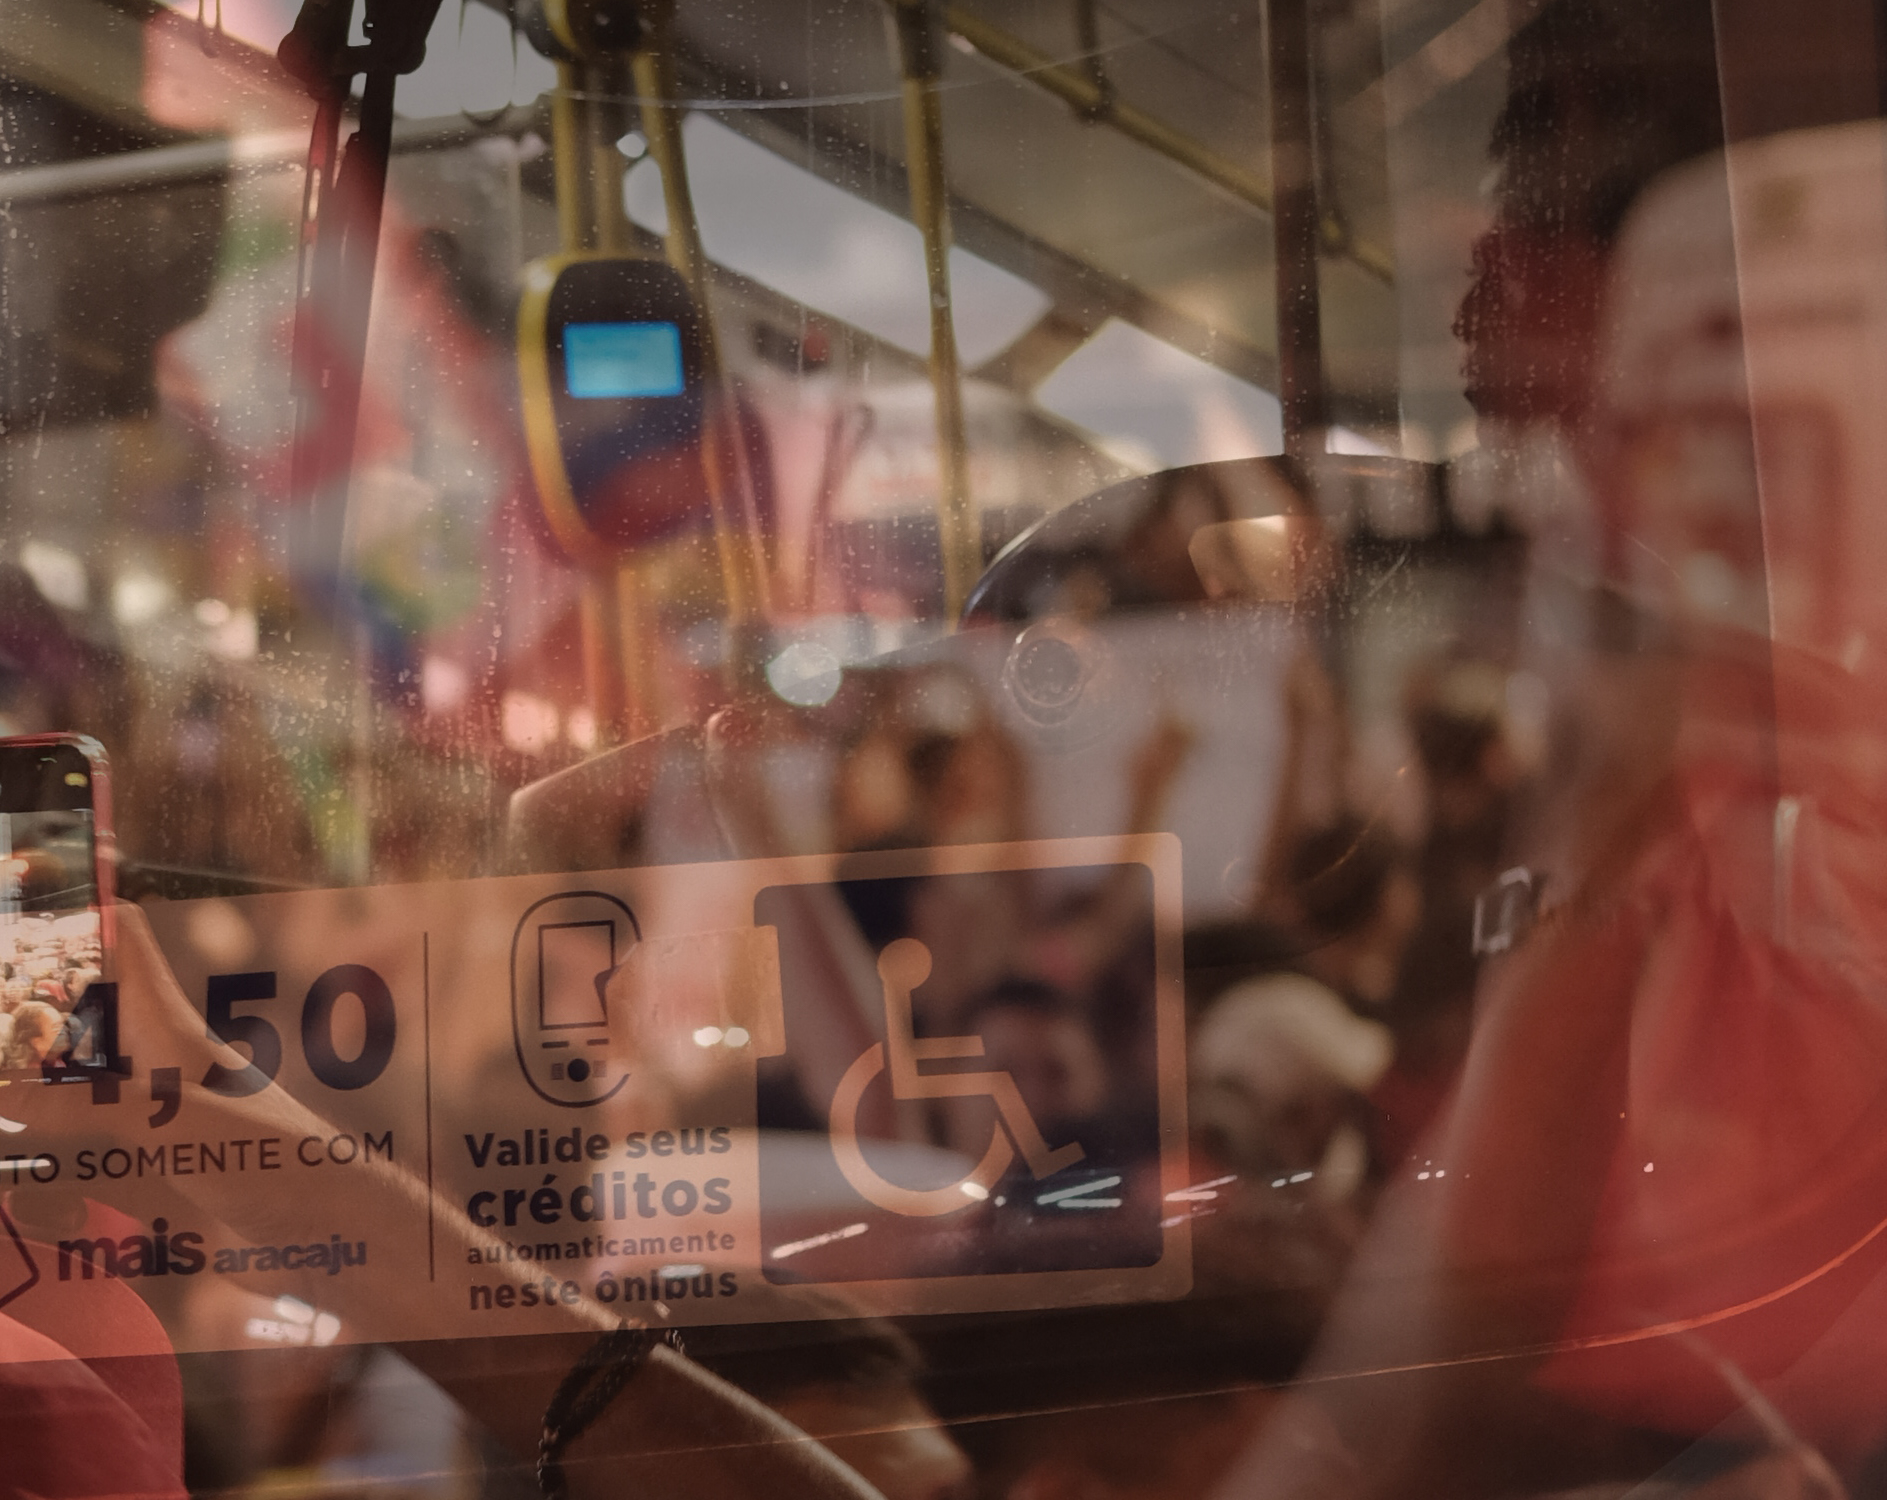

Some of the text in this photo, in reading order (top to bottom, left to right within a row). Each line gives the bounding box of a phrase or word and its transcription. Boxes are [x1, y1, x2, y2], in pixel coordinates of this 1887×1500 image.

[39, 960, 398, 1129] 4,50
[76, 1137, 282, 1182] SOMENTE
[297, 1130, 395, 1167] COM
[464, 1126, 733, 1168] Valide seus
[467, 1172, 732, 1228] créditos
[57, 1216, 369, 1283] mais aracaju
[466, 1230, 737, 1265] automaticamente
[469, 1268, 740, 1311] neste ônibus
